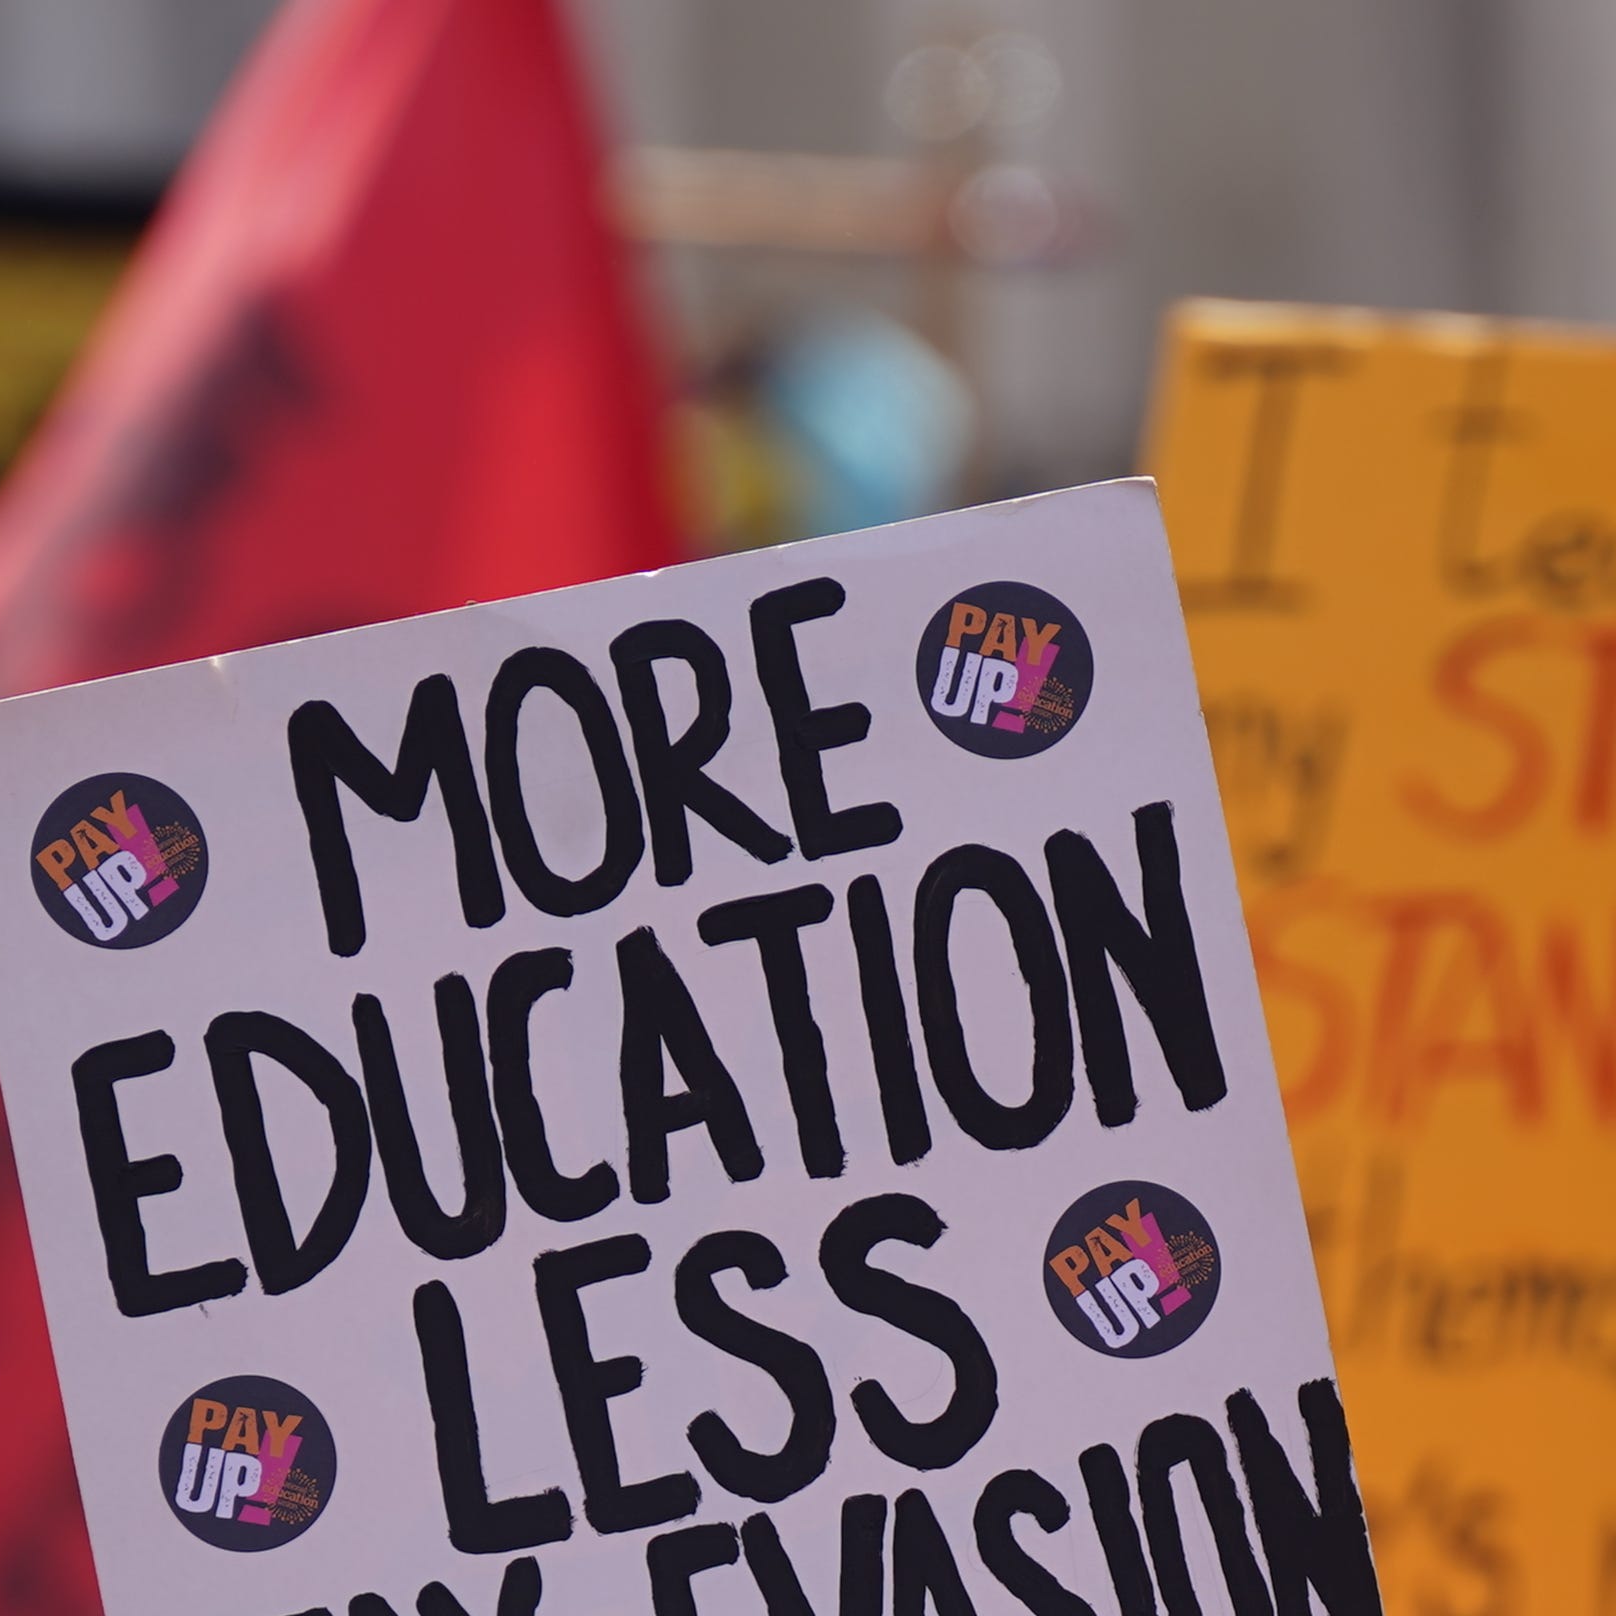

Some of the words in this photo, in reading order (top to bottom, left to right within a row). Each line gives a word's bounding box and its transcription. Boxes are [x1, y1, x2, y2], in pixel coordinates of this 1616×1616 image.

[1183, 342, 1358, 616] I
[932, 638, 1059, 732] UP!
[947, 604, 1059, 667] PAY
[288, 578, 903, 957] MORE
[37, 792, 139, 889] PAY
[64, 805, 178, 940] UP!
[72, 802, 1227, 1317] EDUCATION
[1051, 1200, 1154, 1295] PAY
[1076, 1214, 1191, 1348] UP!
[413, 1181, 998, 1554] LESS
[176, 1431, 301, 1525] UP!
[189, 1400, 301, 1460] PAY
